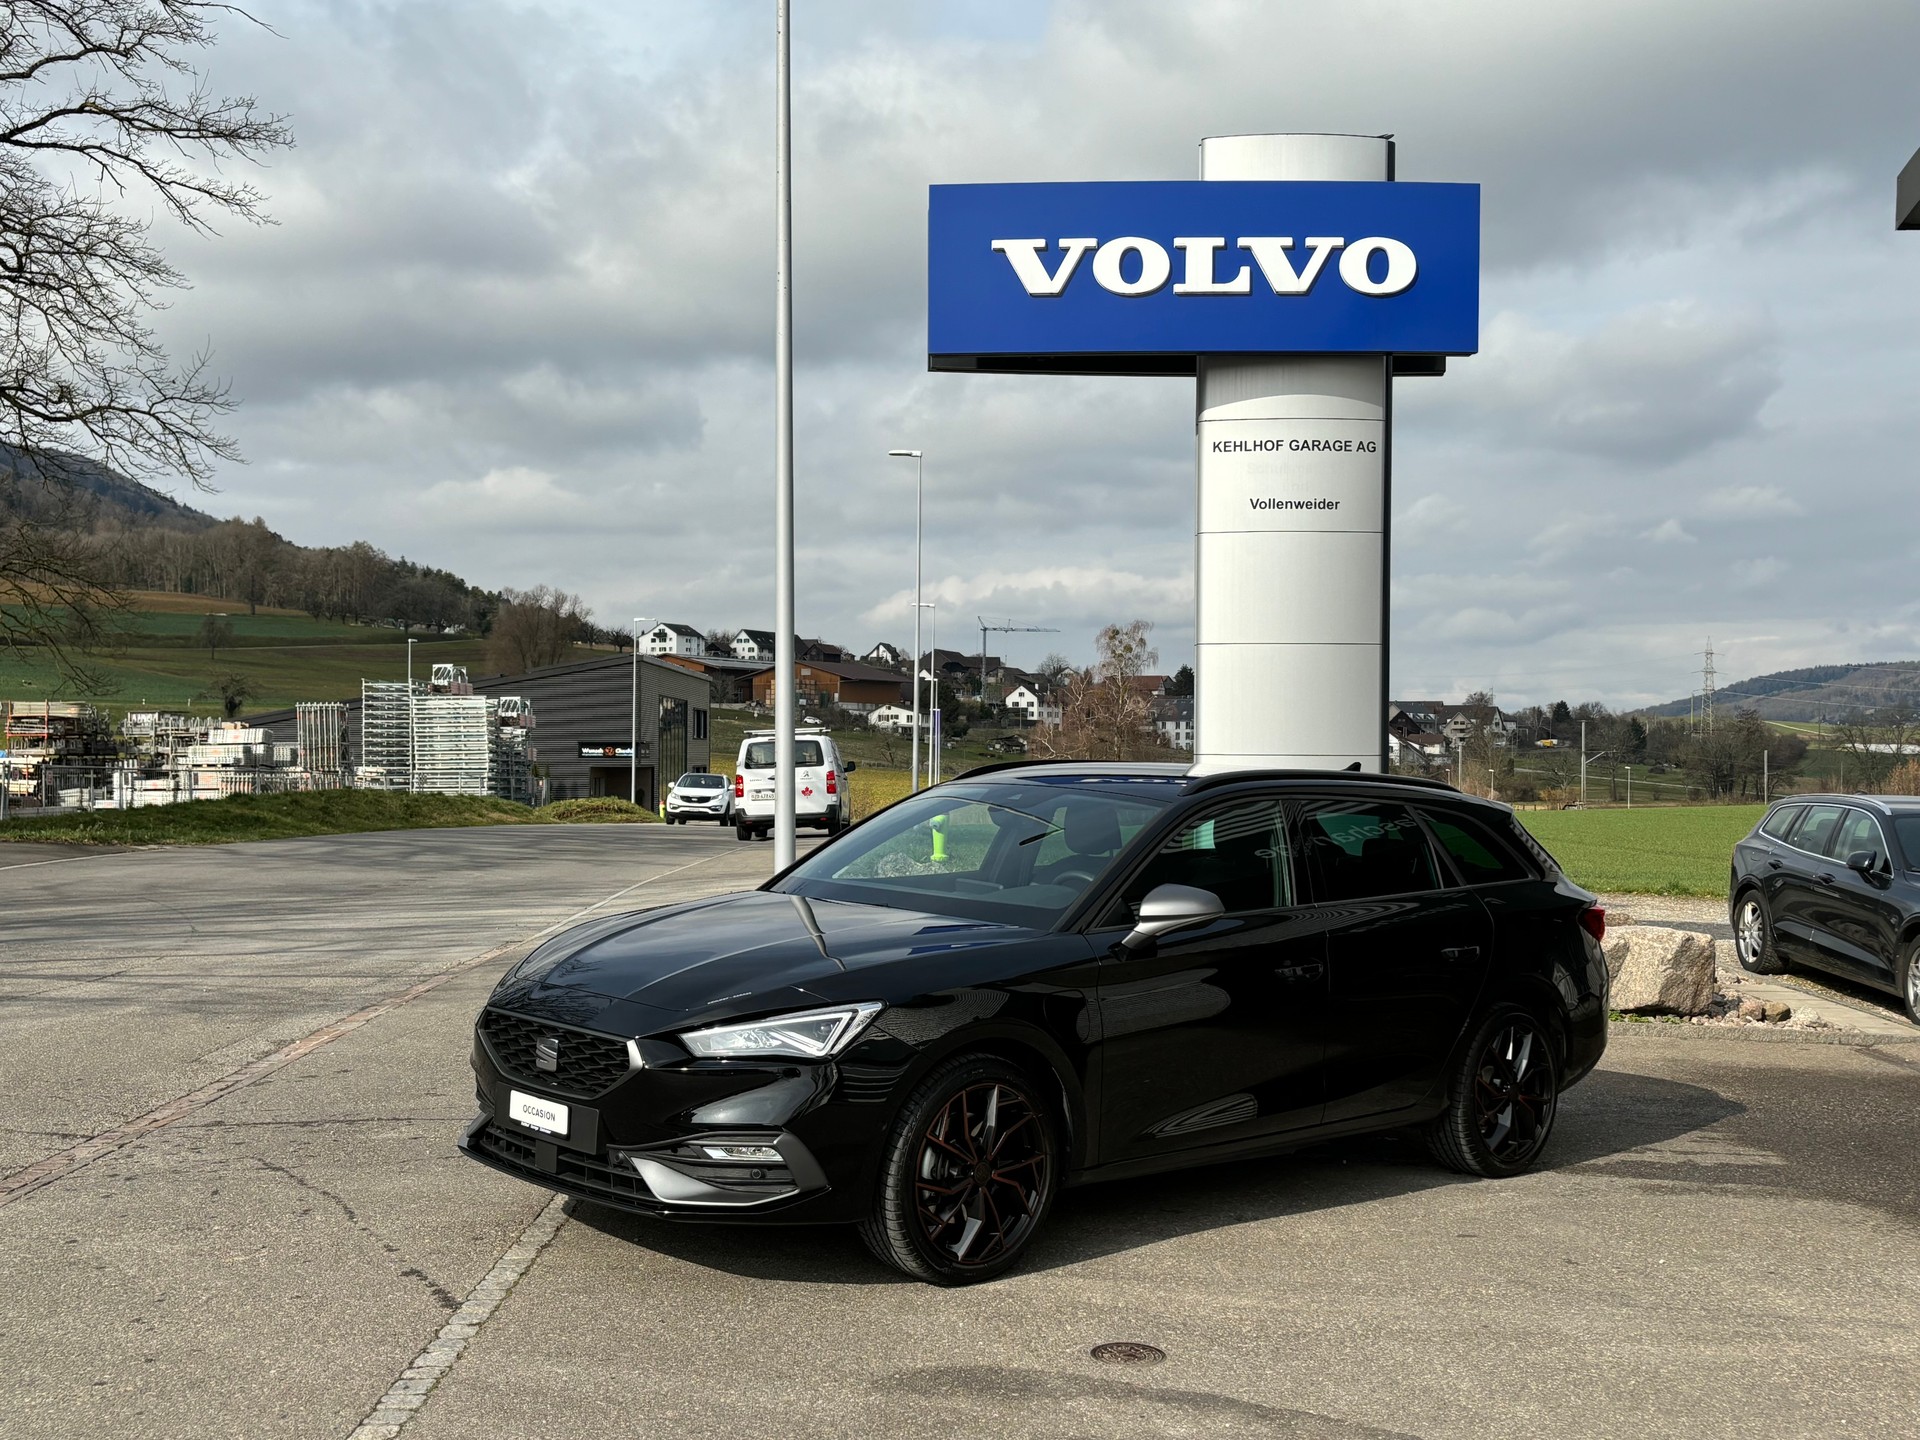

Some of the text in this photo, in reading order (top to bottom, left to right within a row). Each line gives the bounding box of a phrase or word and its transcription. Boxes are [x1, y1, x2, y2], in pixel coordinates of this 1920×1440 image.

[991, 236, 1418, 297] VOLVO
[1212, 439, 1377, 453] KEHLHOF GARAGE AG
[1249, 498, 1341, 510] Vollenweider
[522, 1104, 556, 1122] OCCASION
